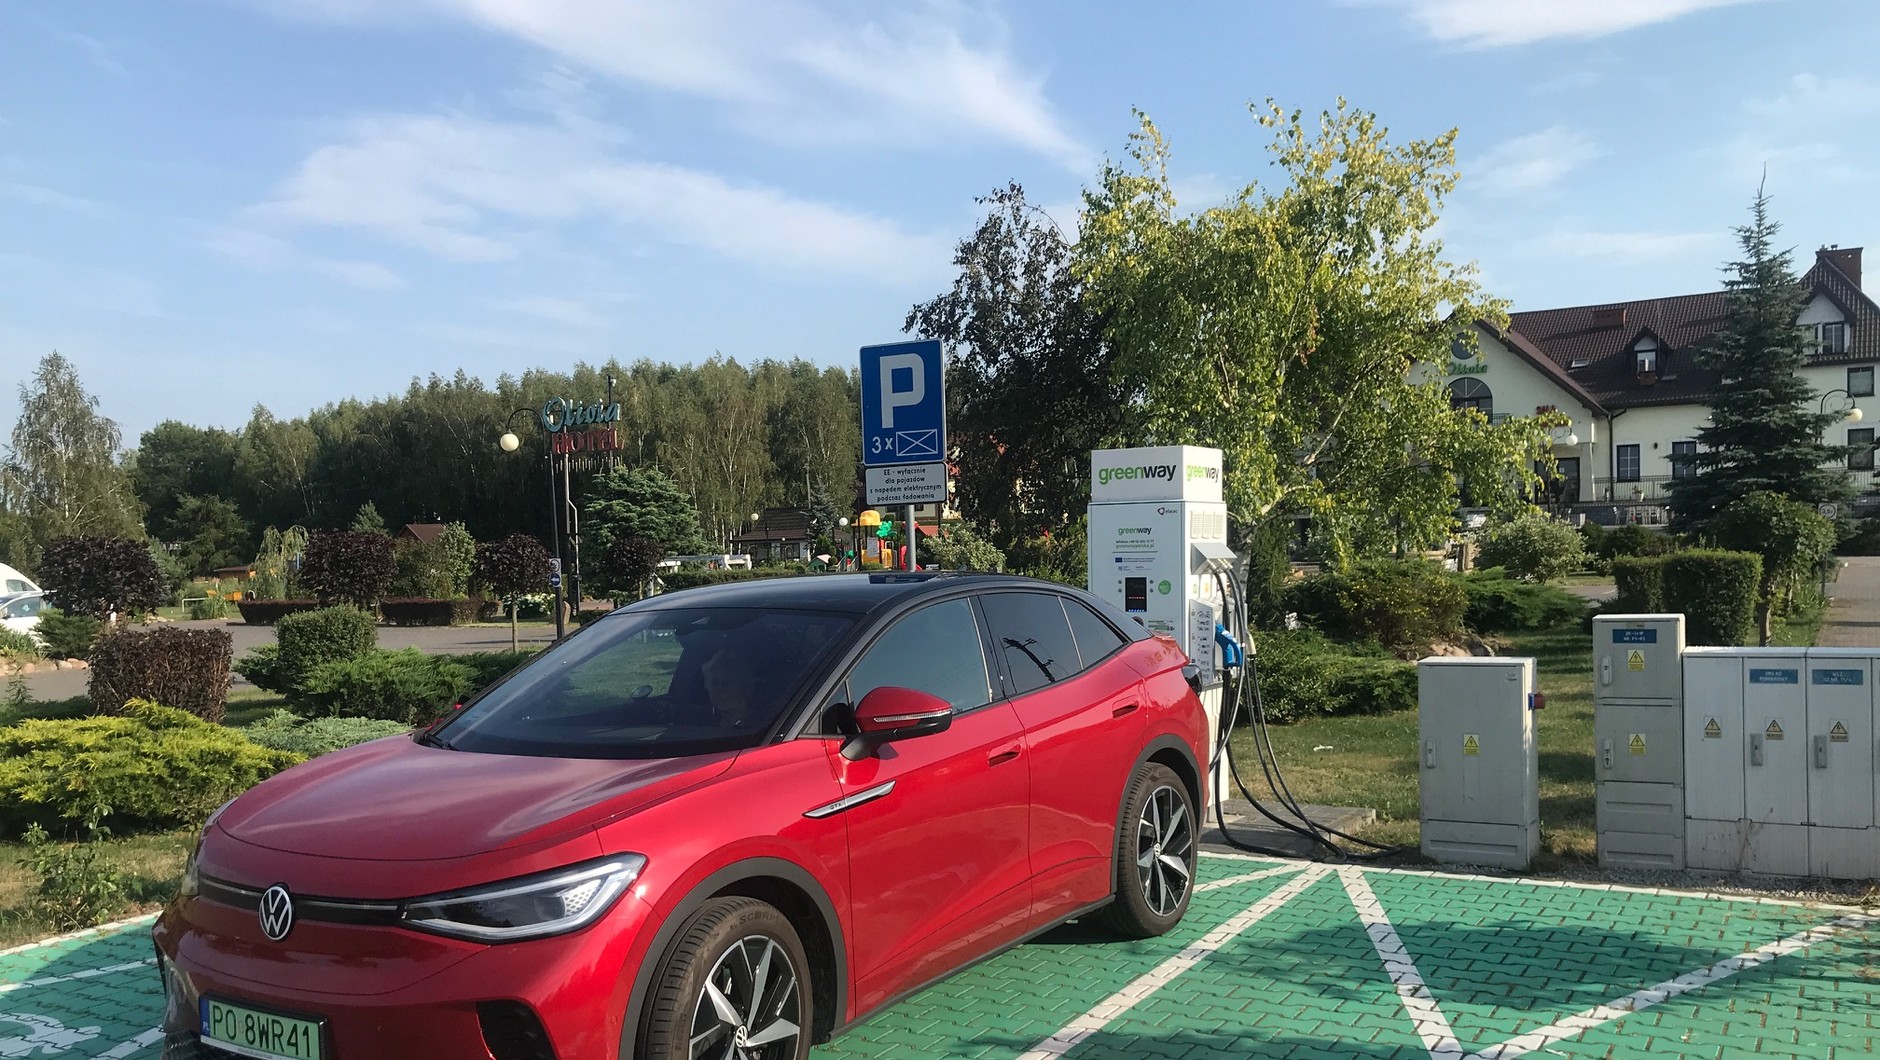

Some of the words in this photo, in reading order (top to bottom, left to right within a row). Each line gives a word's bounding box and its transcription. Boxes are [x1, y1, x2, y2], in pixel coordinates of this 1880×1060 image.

[880, 353, 925, 428] P
[543, 396, 620, 432] Olivia
[552, 427, 624, 454] HOTEL
[872, 436, 882, 454] 3
[885, 437, 893, 450] x
[897, 467, 926, 476] wyłącznie
[1098, 464, 1176, 485] greenway
[1186, 464, 1219, 483] greenway
[904, 484, 942, 492] elektrycznym
[877, 495, 901, 503] podczas
[1118, 527, 1152, 535] greenway
[245, 1013, 310, 1058] 8WR41
